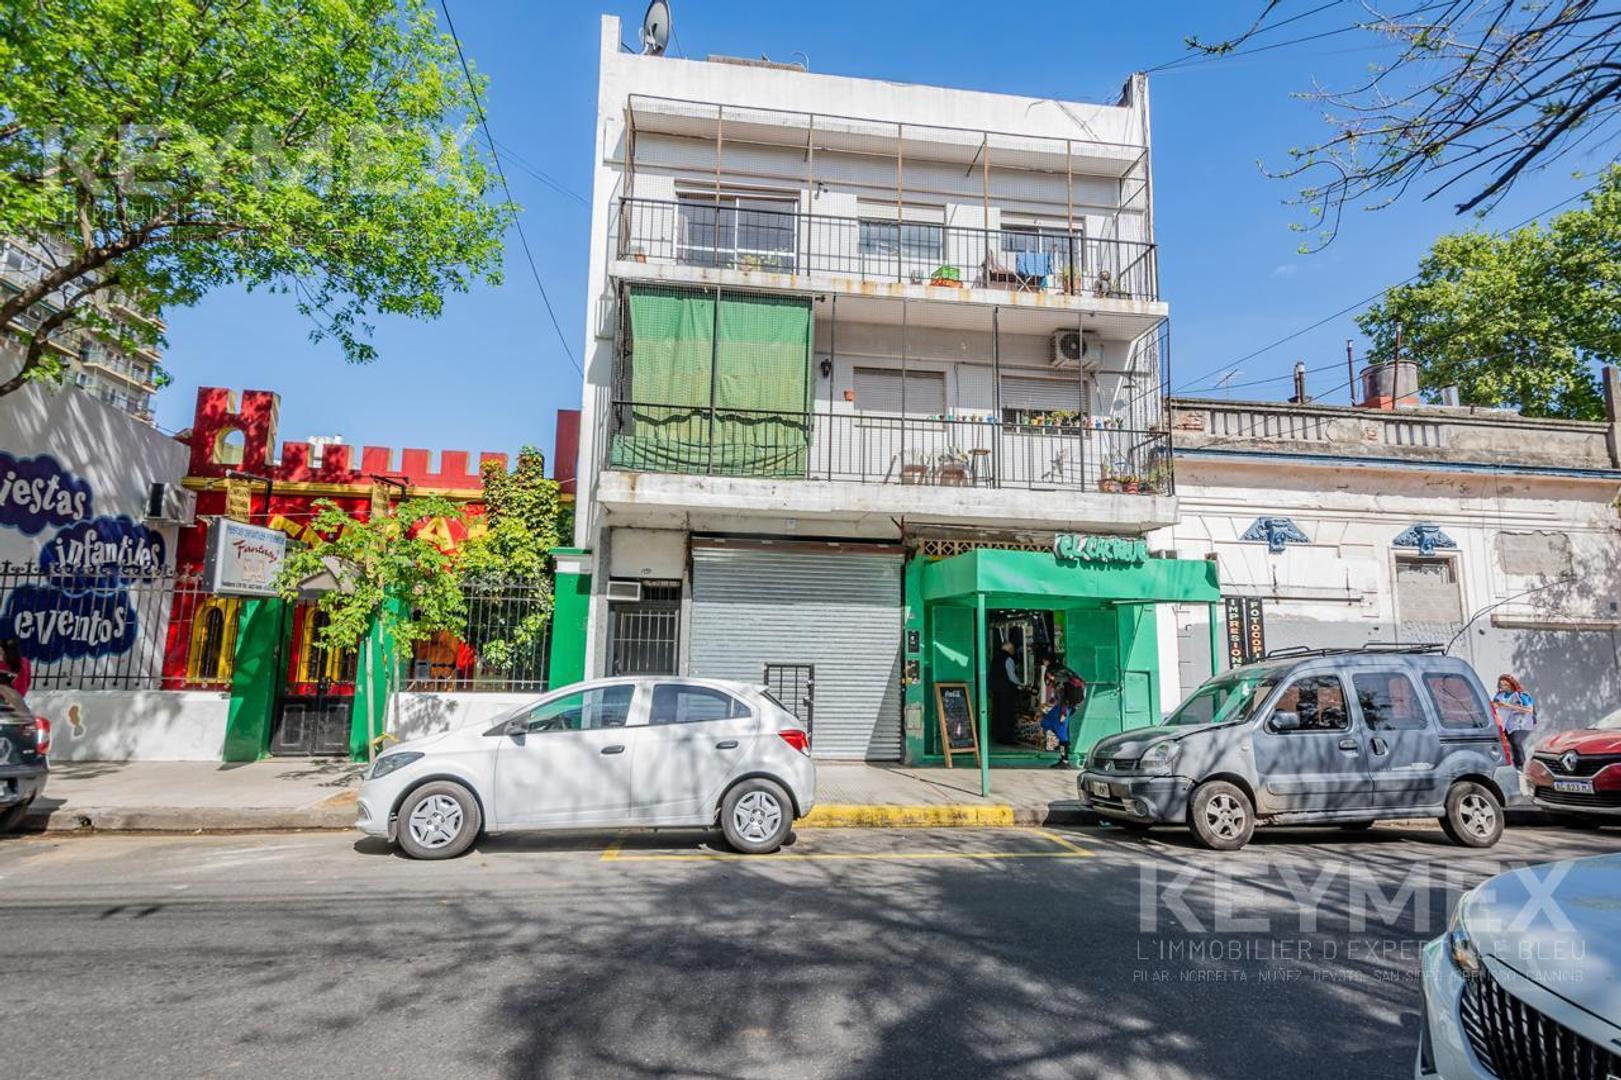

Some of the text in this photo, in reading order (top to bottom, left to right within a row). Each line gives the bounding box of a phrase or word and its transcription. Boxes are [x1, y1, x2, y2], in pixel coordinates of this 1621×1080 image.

[0, 471, 86, 521] iestas
[55, 529, 161, 571] infantiles
[1250, 601, 1262, 664] FOTOCOPI
